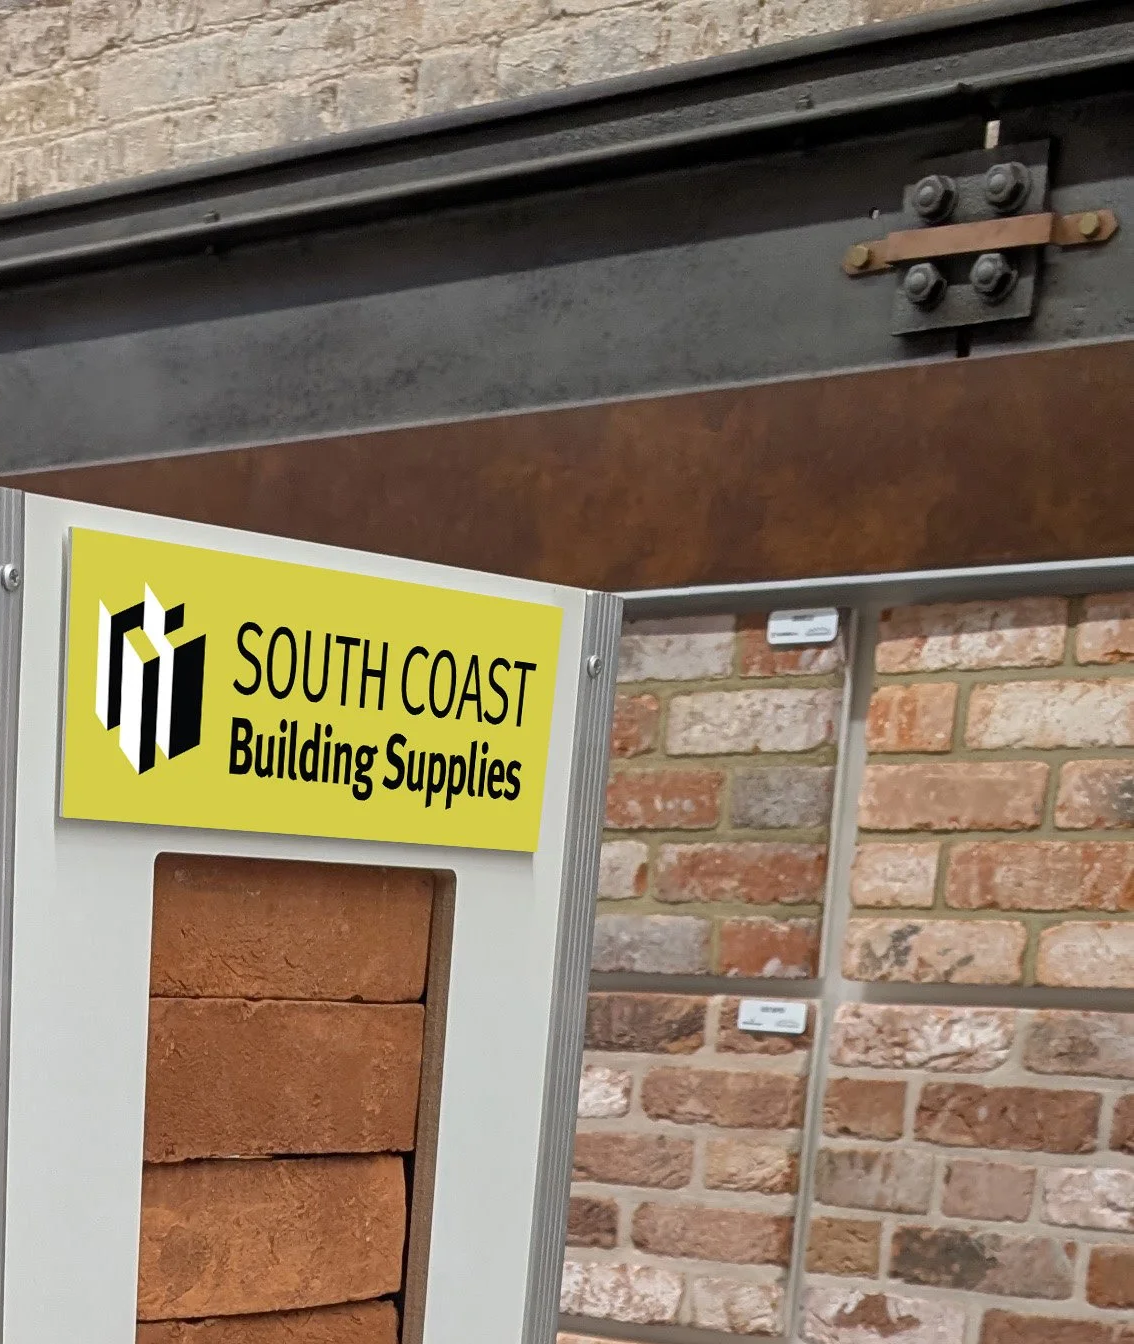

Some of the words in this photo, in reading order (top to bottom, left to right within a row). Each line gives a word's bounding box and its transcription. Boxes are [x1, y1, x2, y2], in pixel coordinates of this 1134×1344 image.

[233, 621, 388, 710] SOUTH
[401, 646, 537, 727] COAST
[229, 716, 378, 801] Building
[382, 733, 521, 810] Supplies
